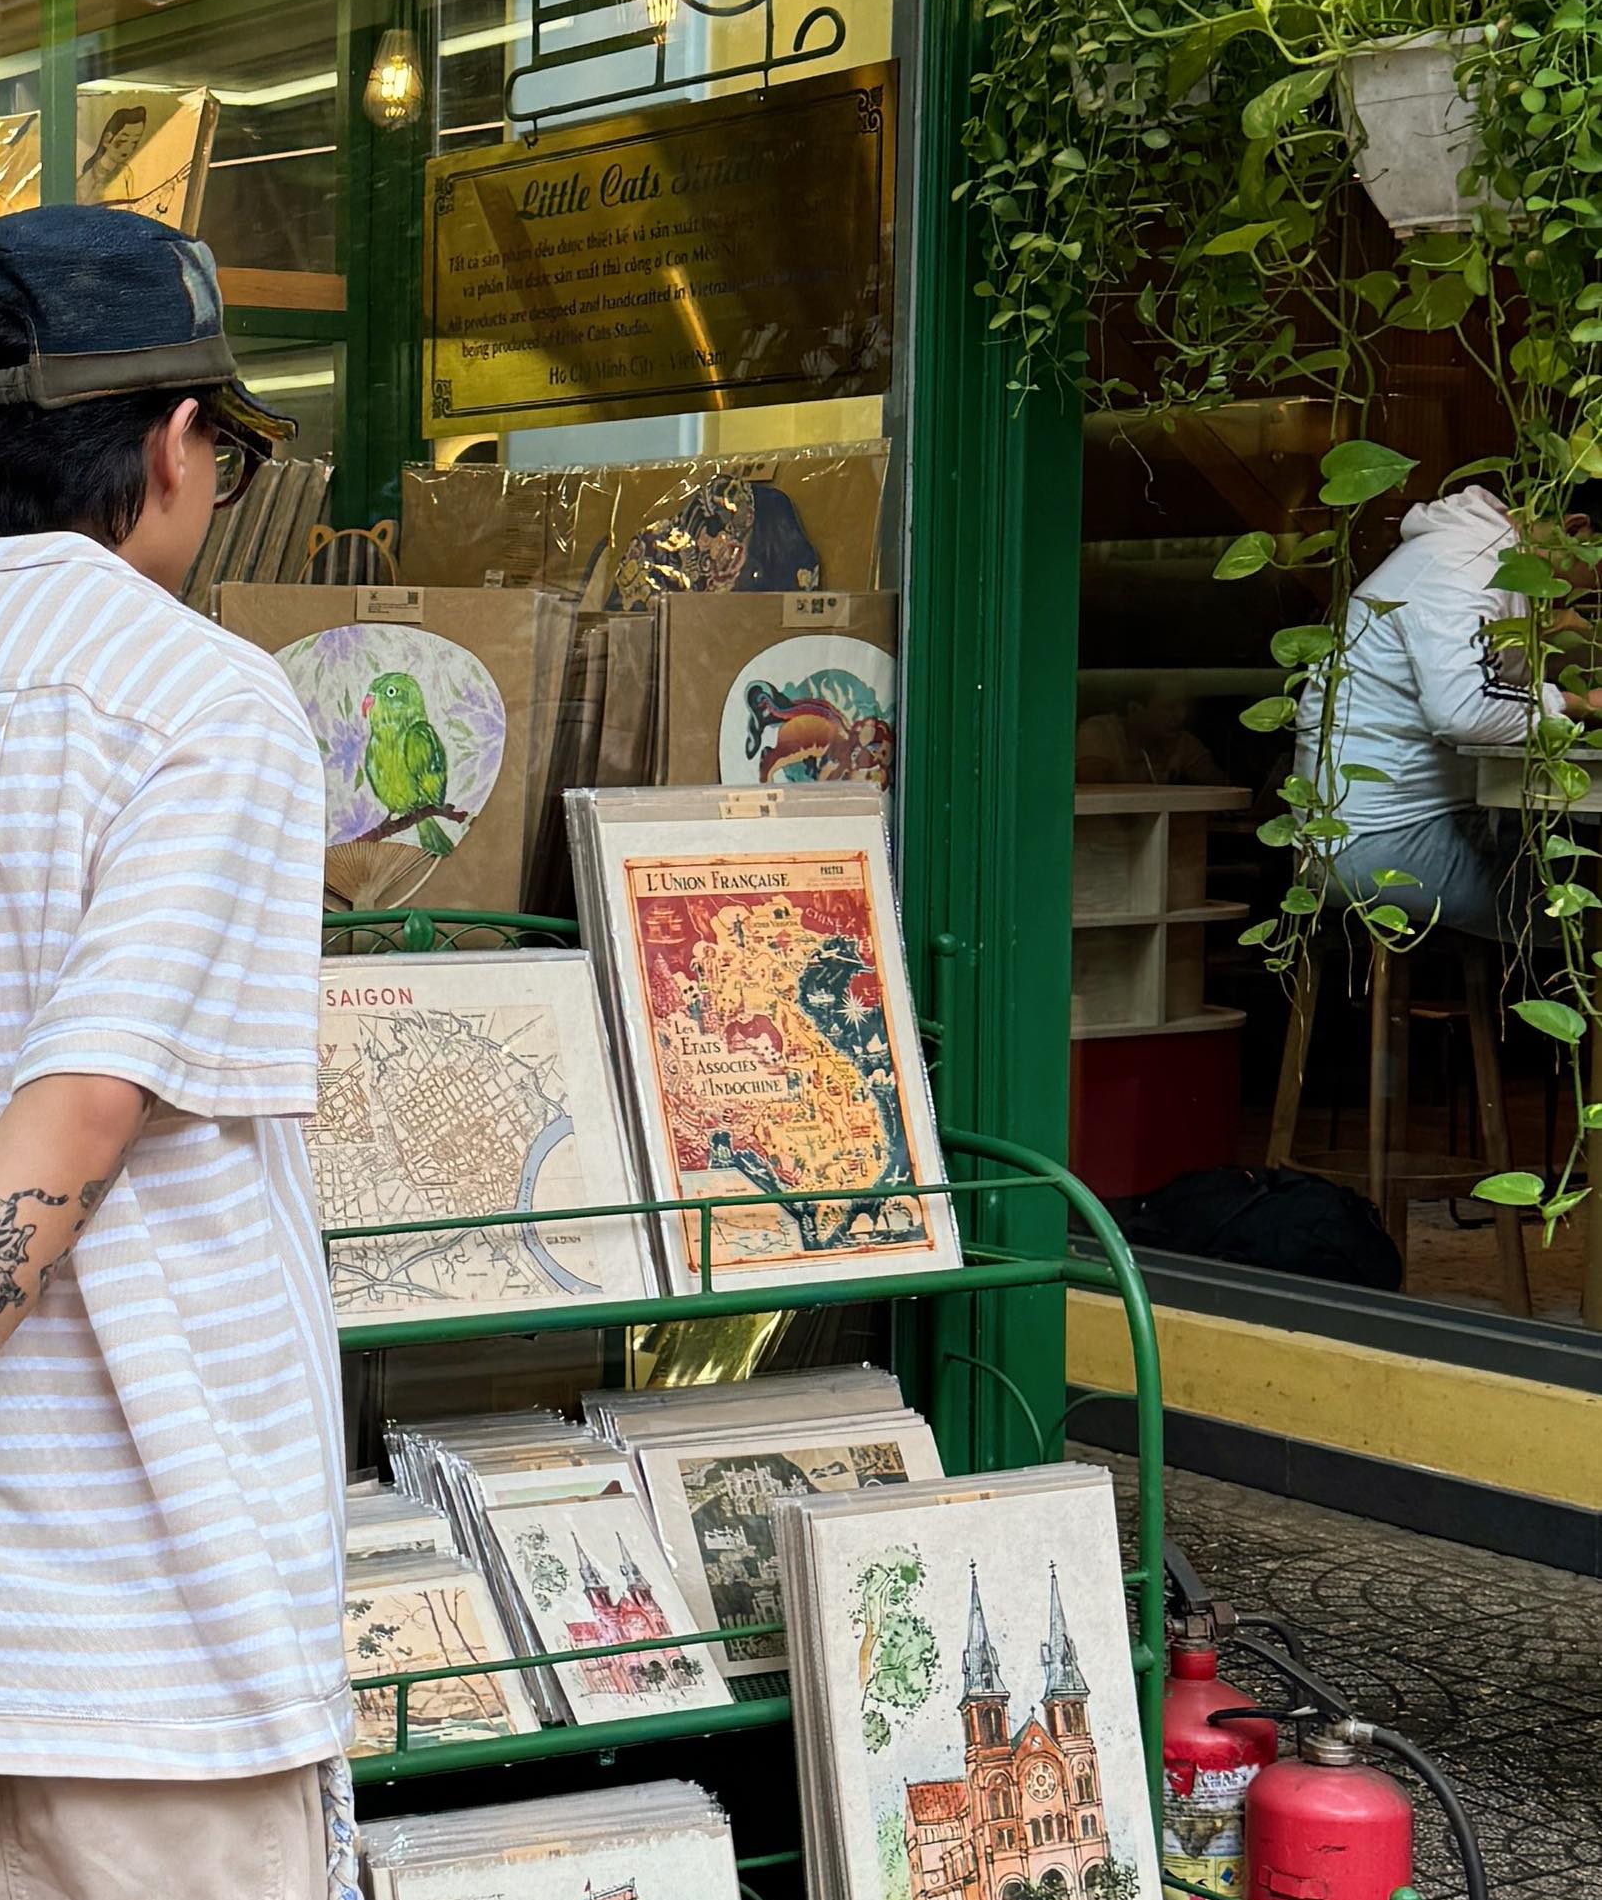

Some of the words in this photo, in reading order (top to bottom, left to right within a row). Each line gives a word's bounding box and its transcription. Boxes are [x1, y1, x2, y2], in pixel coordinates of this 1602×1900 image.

[515, 173, 590, 221] Little
[601, 163, 663, 208] Cats
[326, 987, 414, 1007] SAIGON
